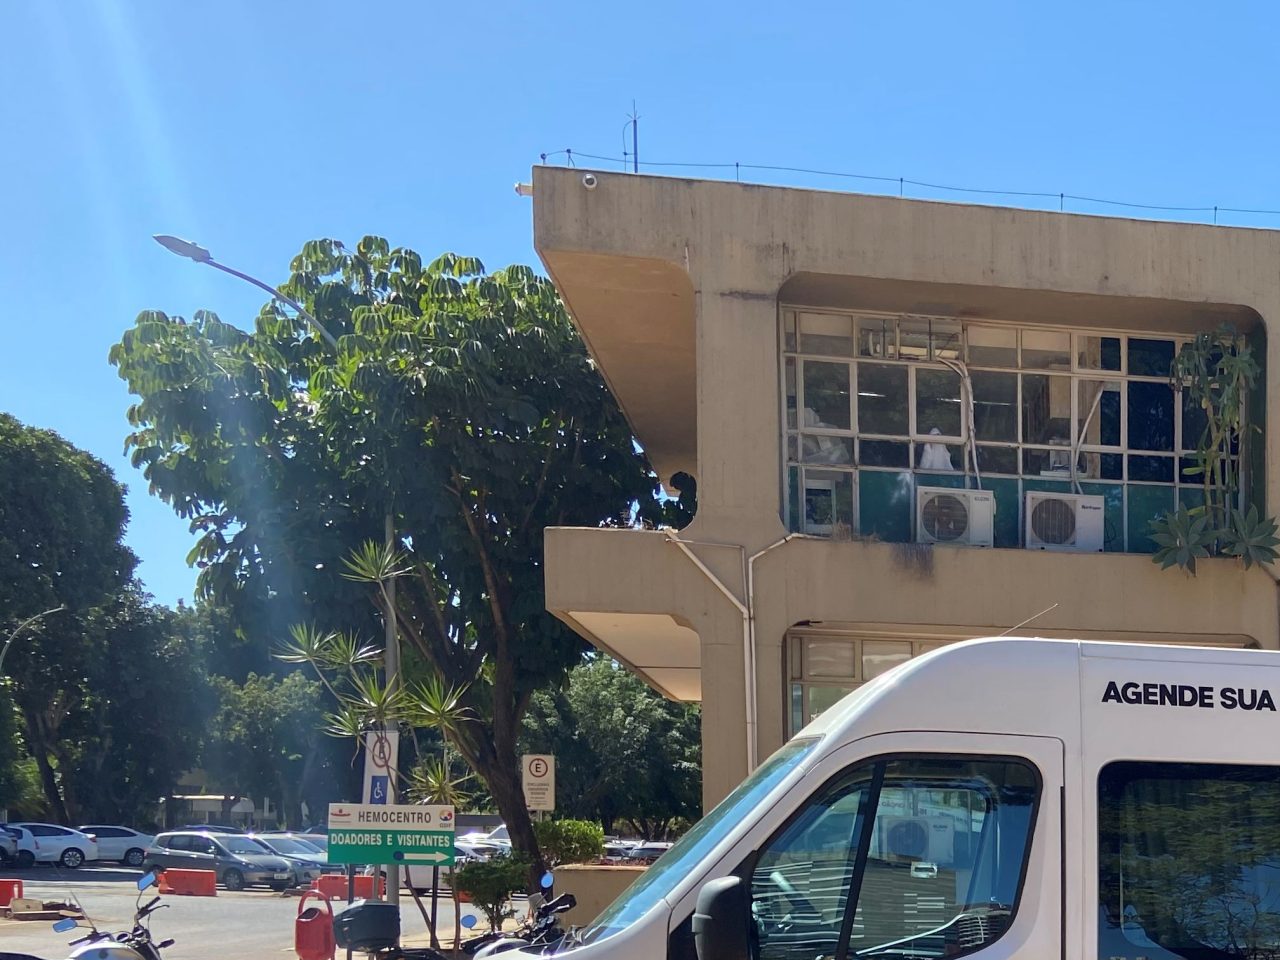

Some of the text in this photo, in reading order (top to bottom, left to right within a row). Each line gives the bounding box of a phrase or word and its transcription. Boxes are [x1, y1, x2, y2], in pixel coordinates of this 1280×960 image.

[1101, 680, 1215, 709] AGENDE
[1219, 687, 1277, 712] SUA
[535, 763, 542, 773] E
[358, 811, 432, 823] HEMOCENTRO
[330, 832, 450, 847] DOADORES E VISITANTES
